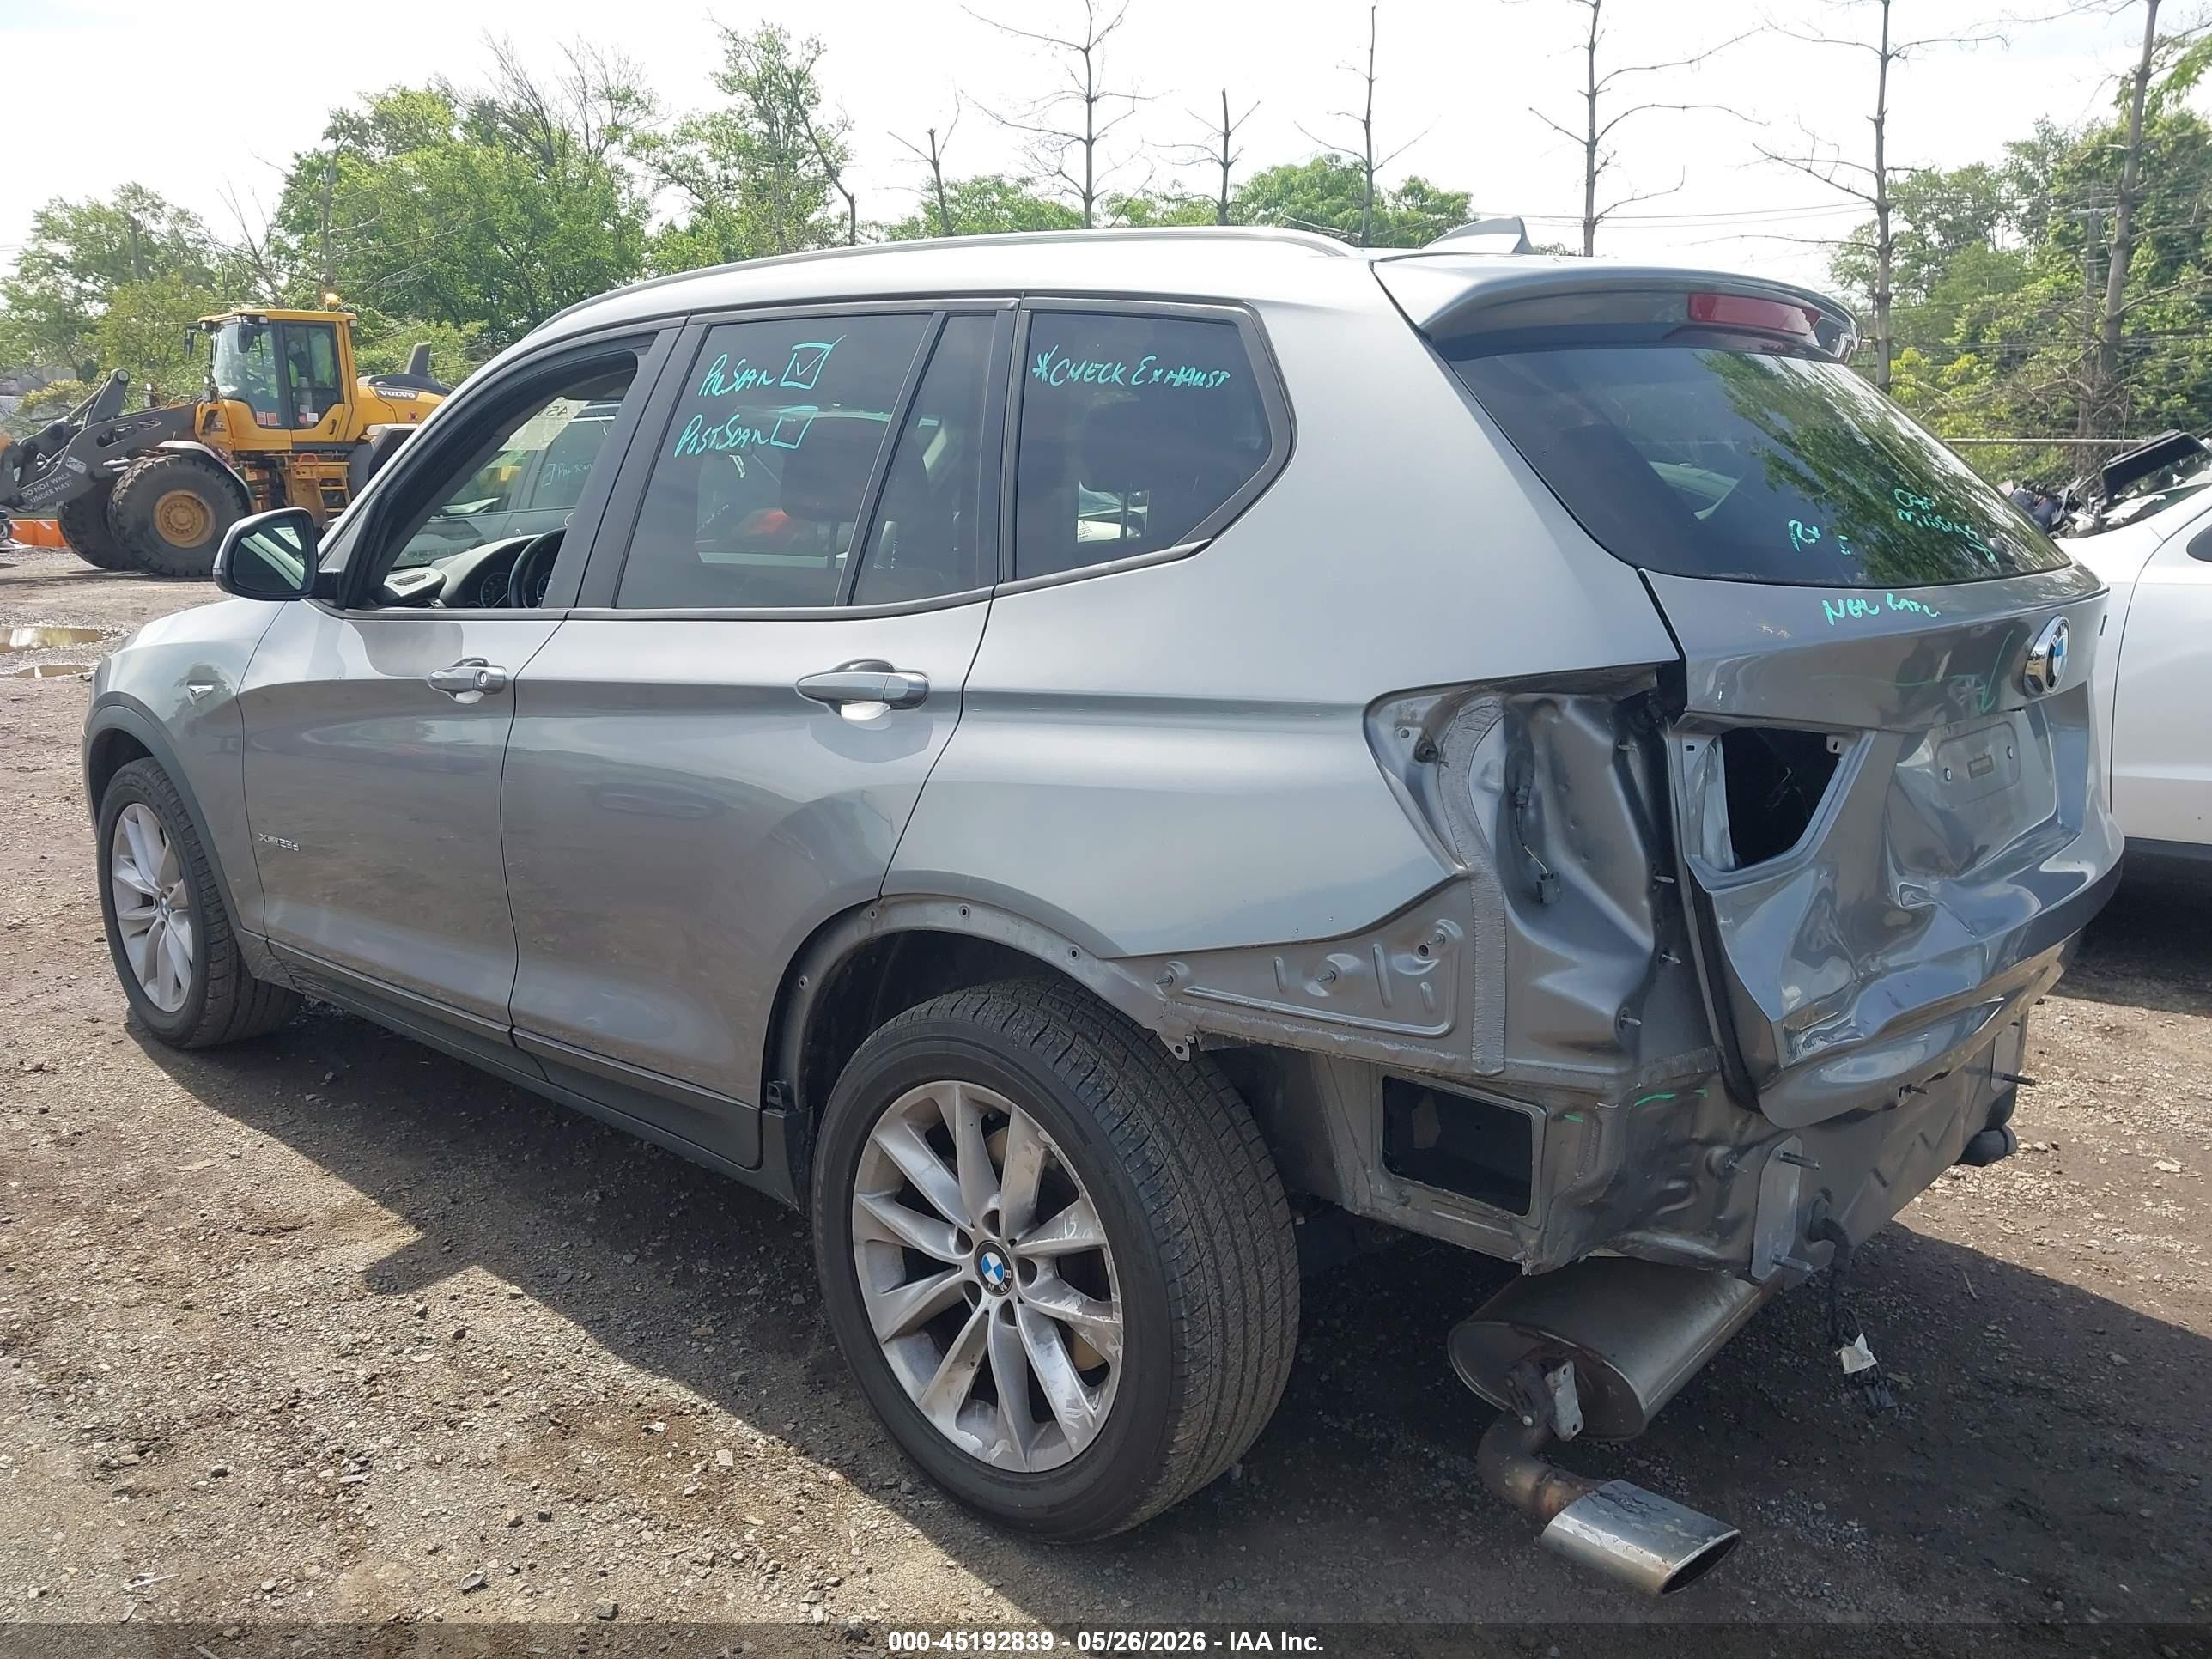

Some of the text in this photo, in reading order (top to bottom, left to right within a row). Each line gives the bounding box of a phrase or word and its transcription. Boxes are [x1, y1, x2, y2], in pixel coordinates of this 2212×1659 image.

[379, 390, 416, 398] VOLVO
[21, 471, 73, 499] DO NOT WALK
[29, 479, 74, 504] UNDER MAST
